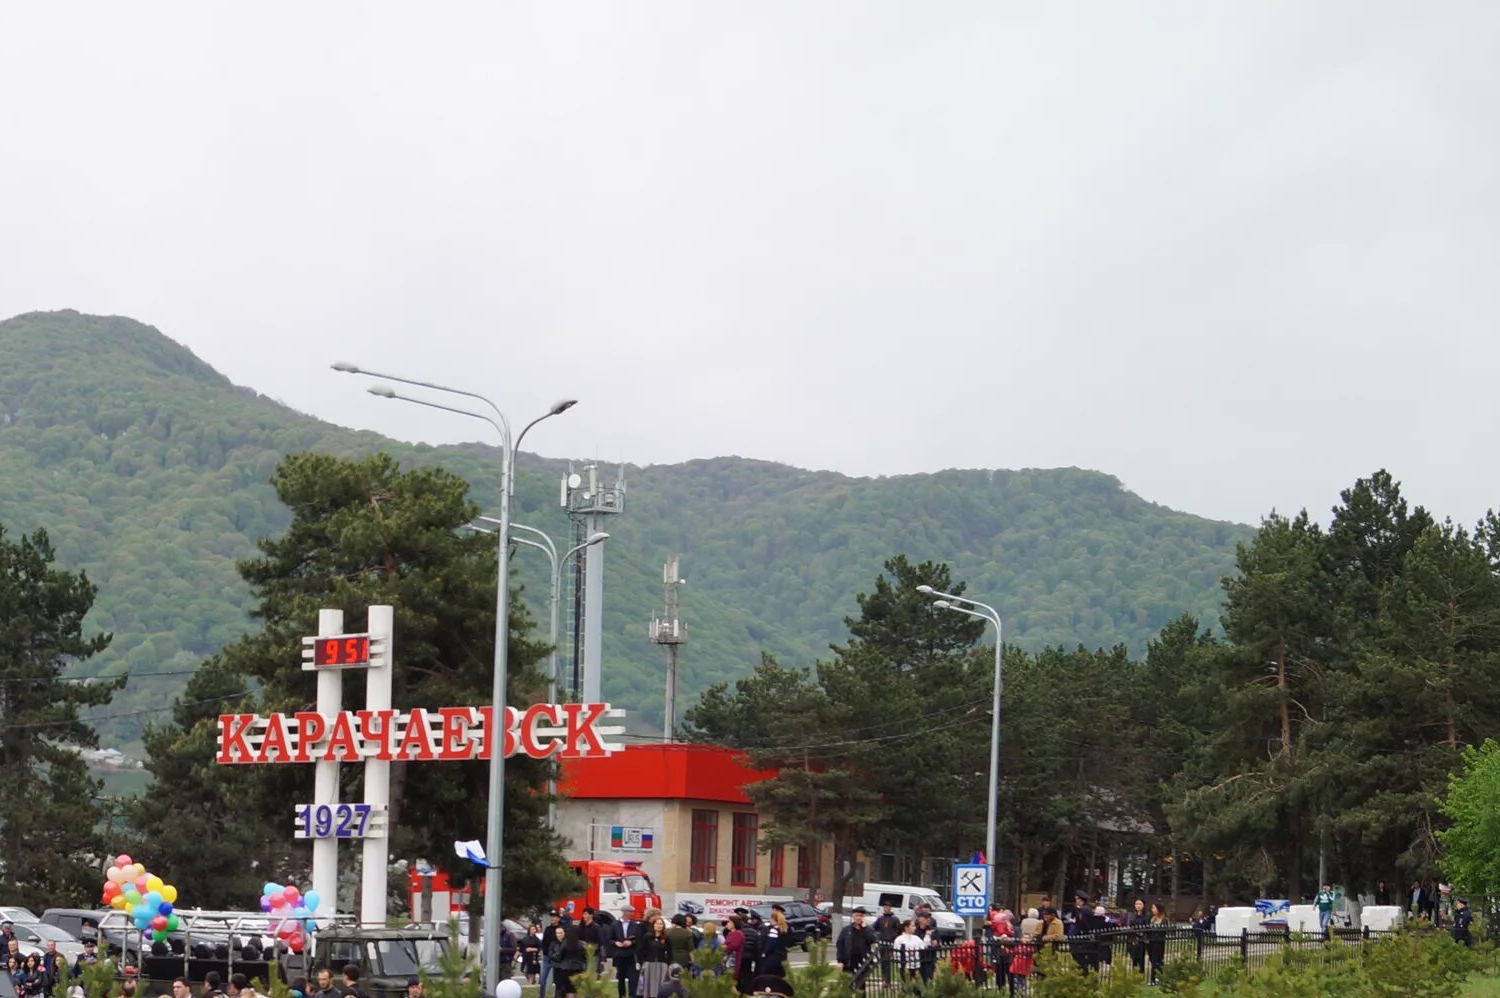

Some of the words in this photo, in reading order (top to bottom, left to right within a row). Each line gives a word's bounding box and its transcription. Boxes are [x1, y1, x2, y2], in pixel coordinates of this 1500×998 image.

[217, 703, 609, 764] КАРАЧАЕВСК
[299, 804, 371, 837] 1927
[957, 896, 985, 907] СТО
